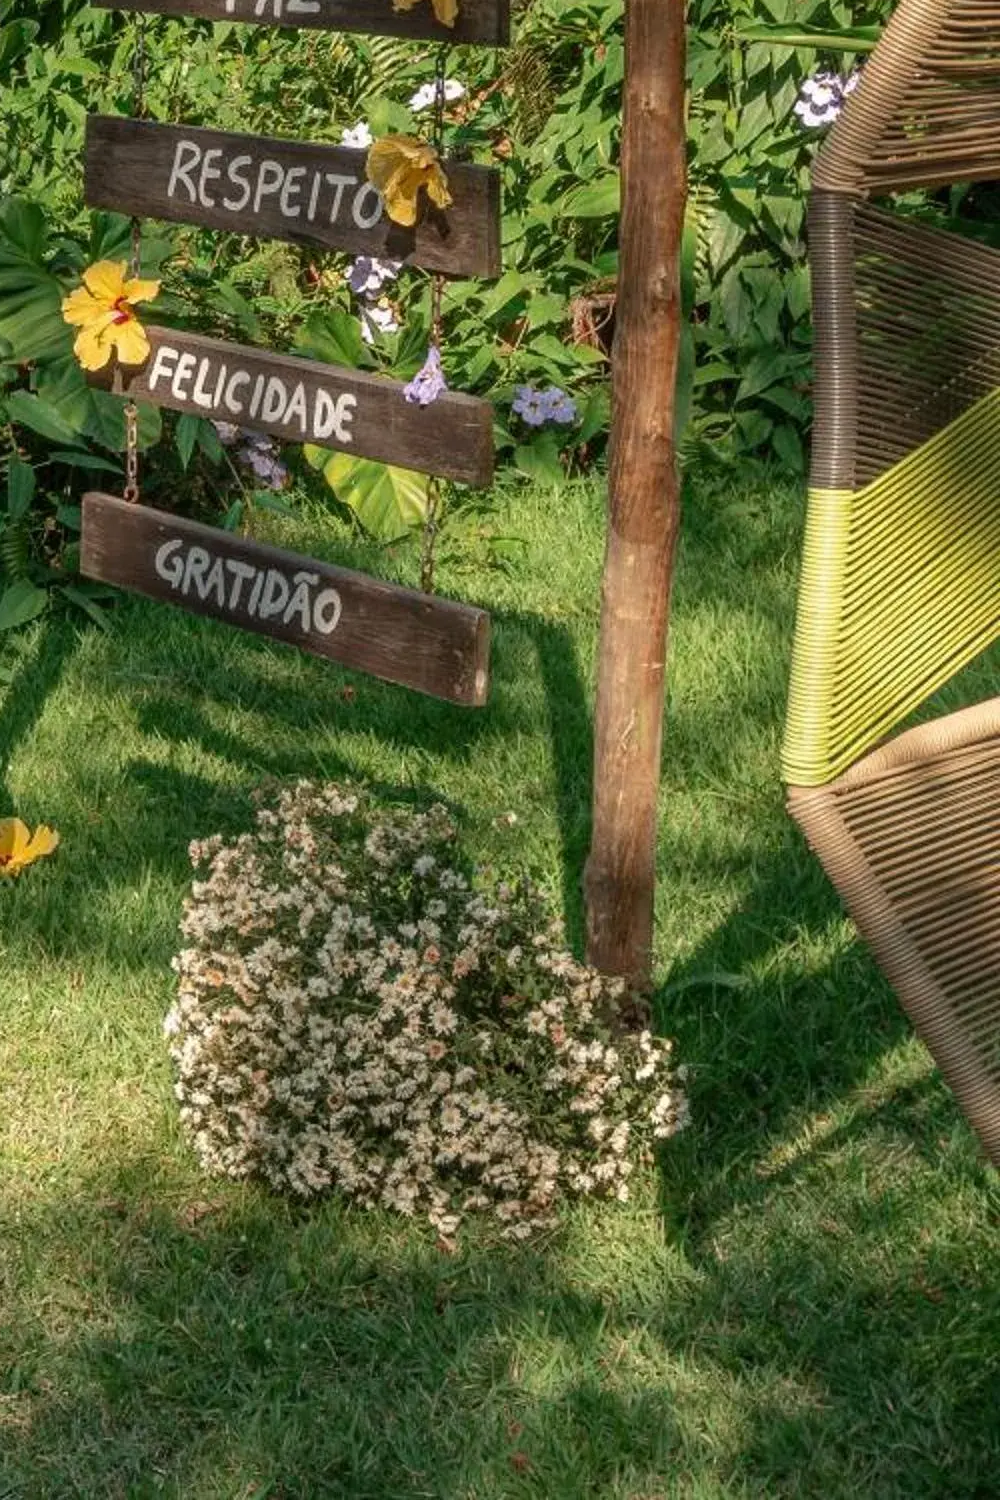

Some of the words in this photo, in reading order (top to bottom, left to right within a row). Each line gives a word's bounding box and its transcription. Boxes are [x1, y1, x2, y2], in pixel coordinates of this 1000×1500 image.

[167, 139, 384, 230] RESPEITO
[147, 345, 358, 444] FELICIDADE
[153, 538, 342, 636] GRATIDÃO
